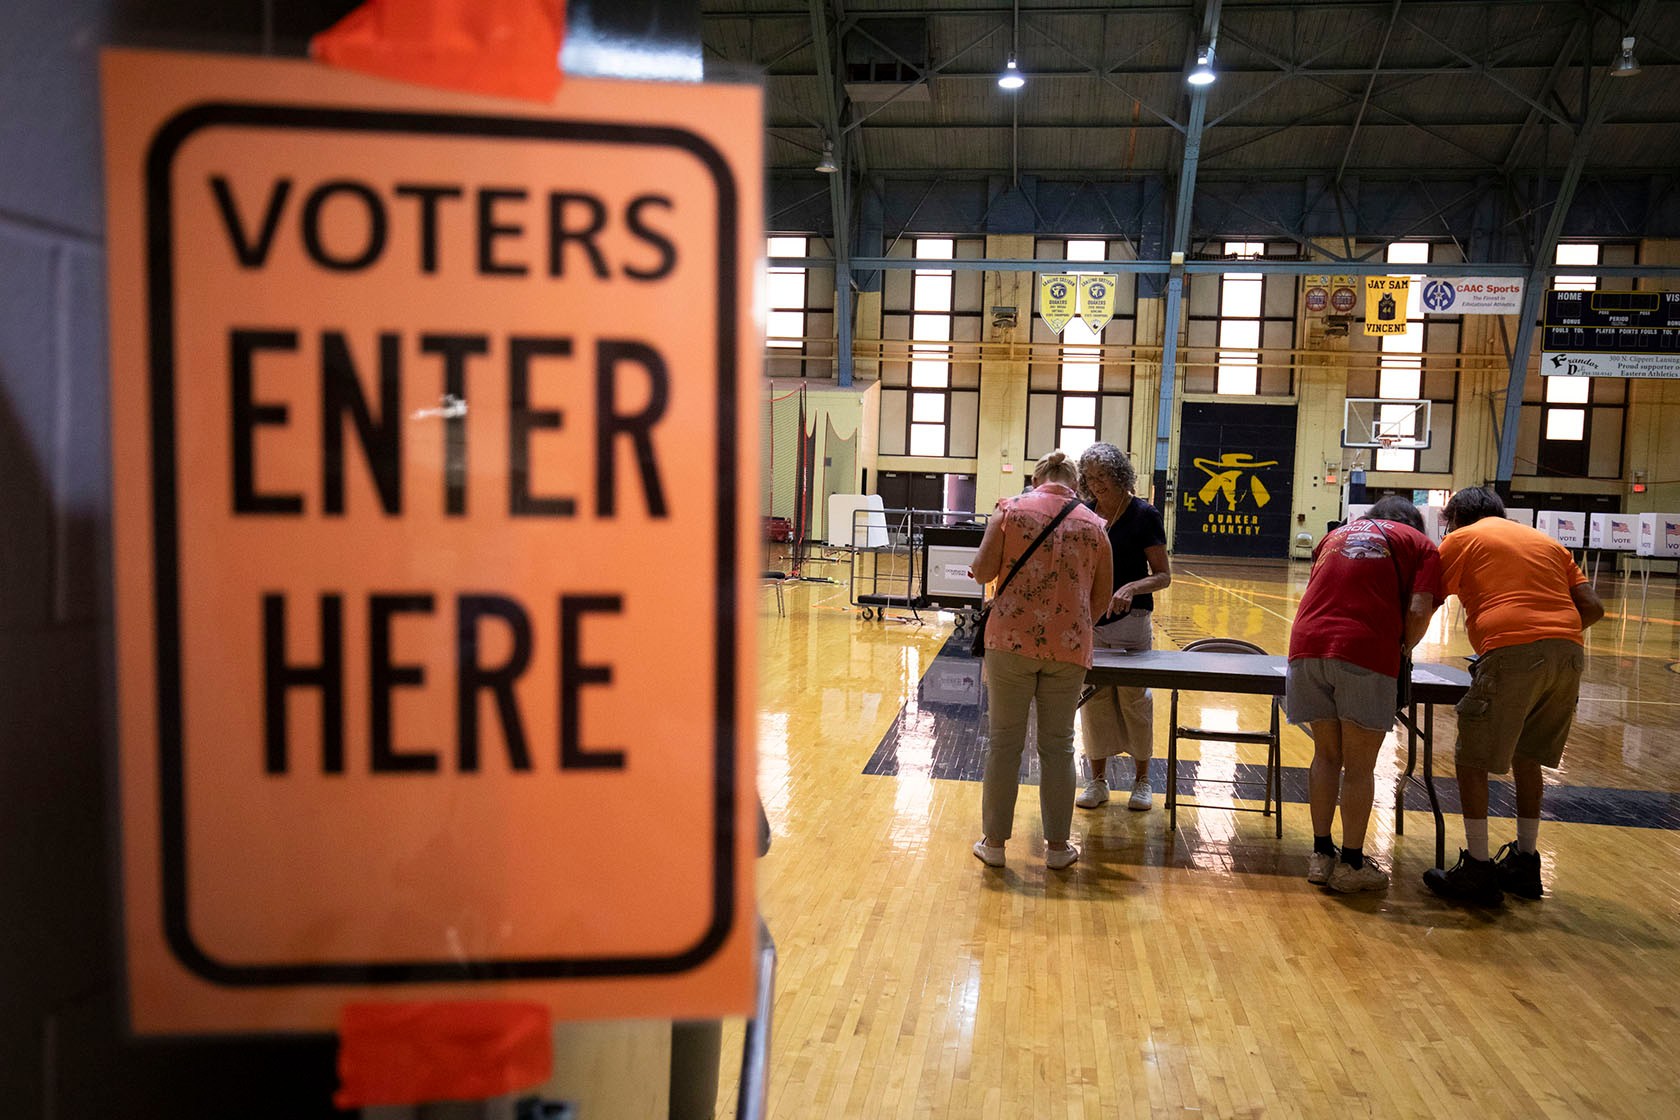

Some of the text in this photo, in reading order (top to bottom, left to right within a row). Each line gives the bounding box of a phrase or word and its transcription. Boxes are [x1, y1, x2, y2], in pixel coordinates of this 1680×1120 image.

[207, 173, 682, 284] VOTERS
[1368, 280, 1408, 289] JAY SAM
[1456, 284, 1520, 294] CAAC Sports
[1557, 292, 1582, 300] HOME
[1666, 294, 1680, 302] VIS
[1366, 323, 1406, 332] VINCENT
[1550, 354, 1598, 369] Frandor
[225, 328, 675, 523] ENTER
[1208, 513, 1258, 524] QUAKER
[1202, 523, 1260, 535] COUNTRY
[259, 589, 629, 778] HERE
